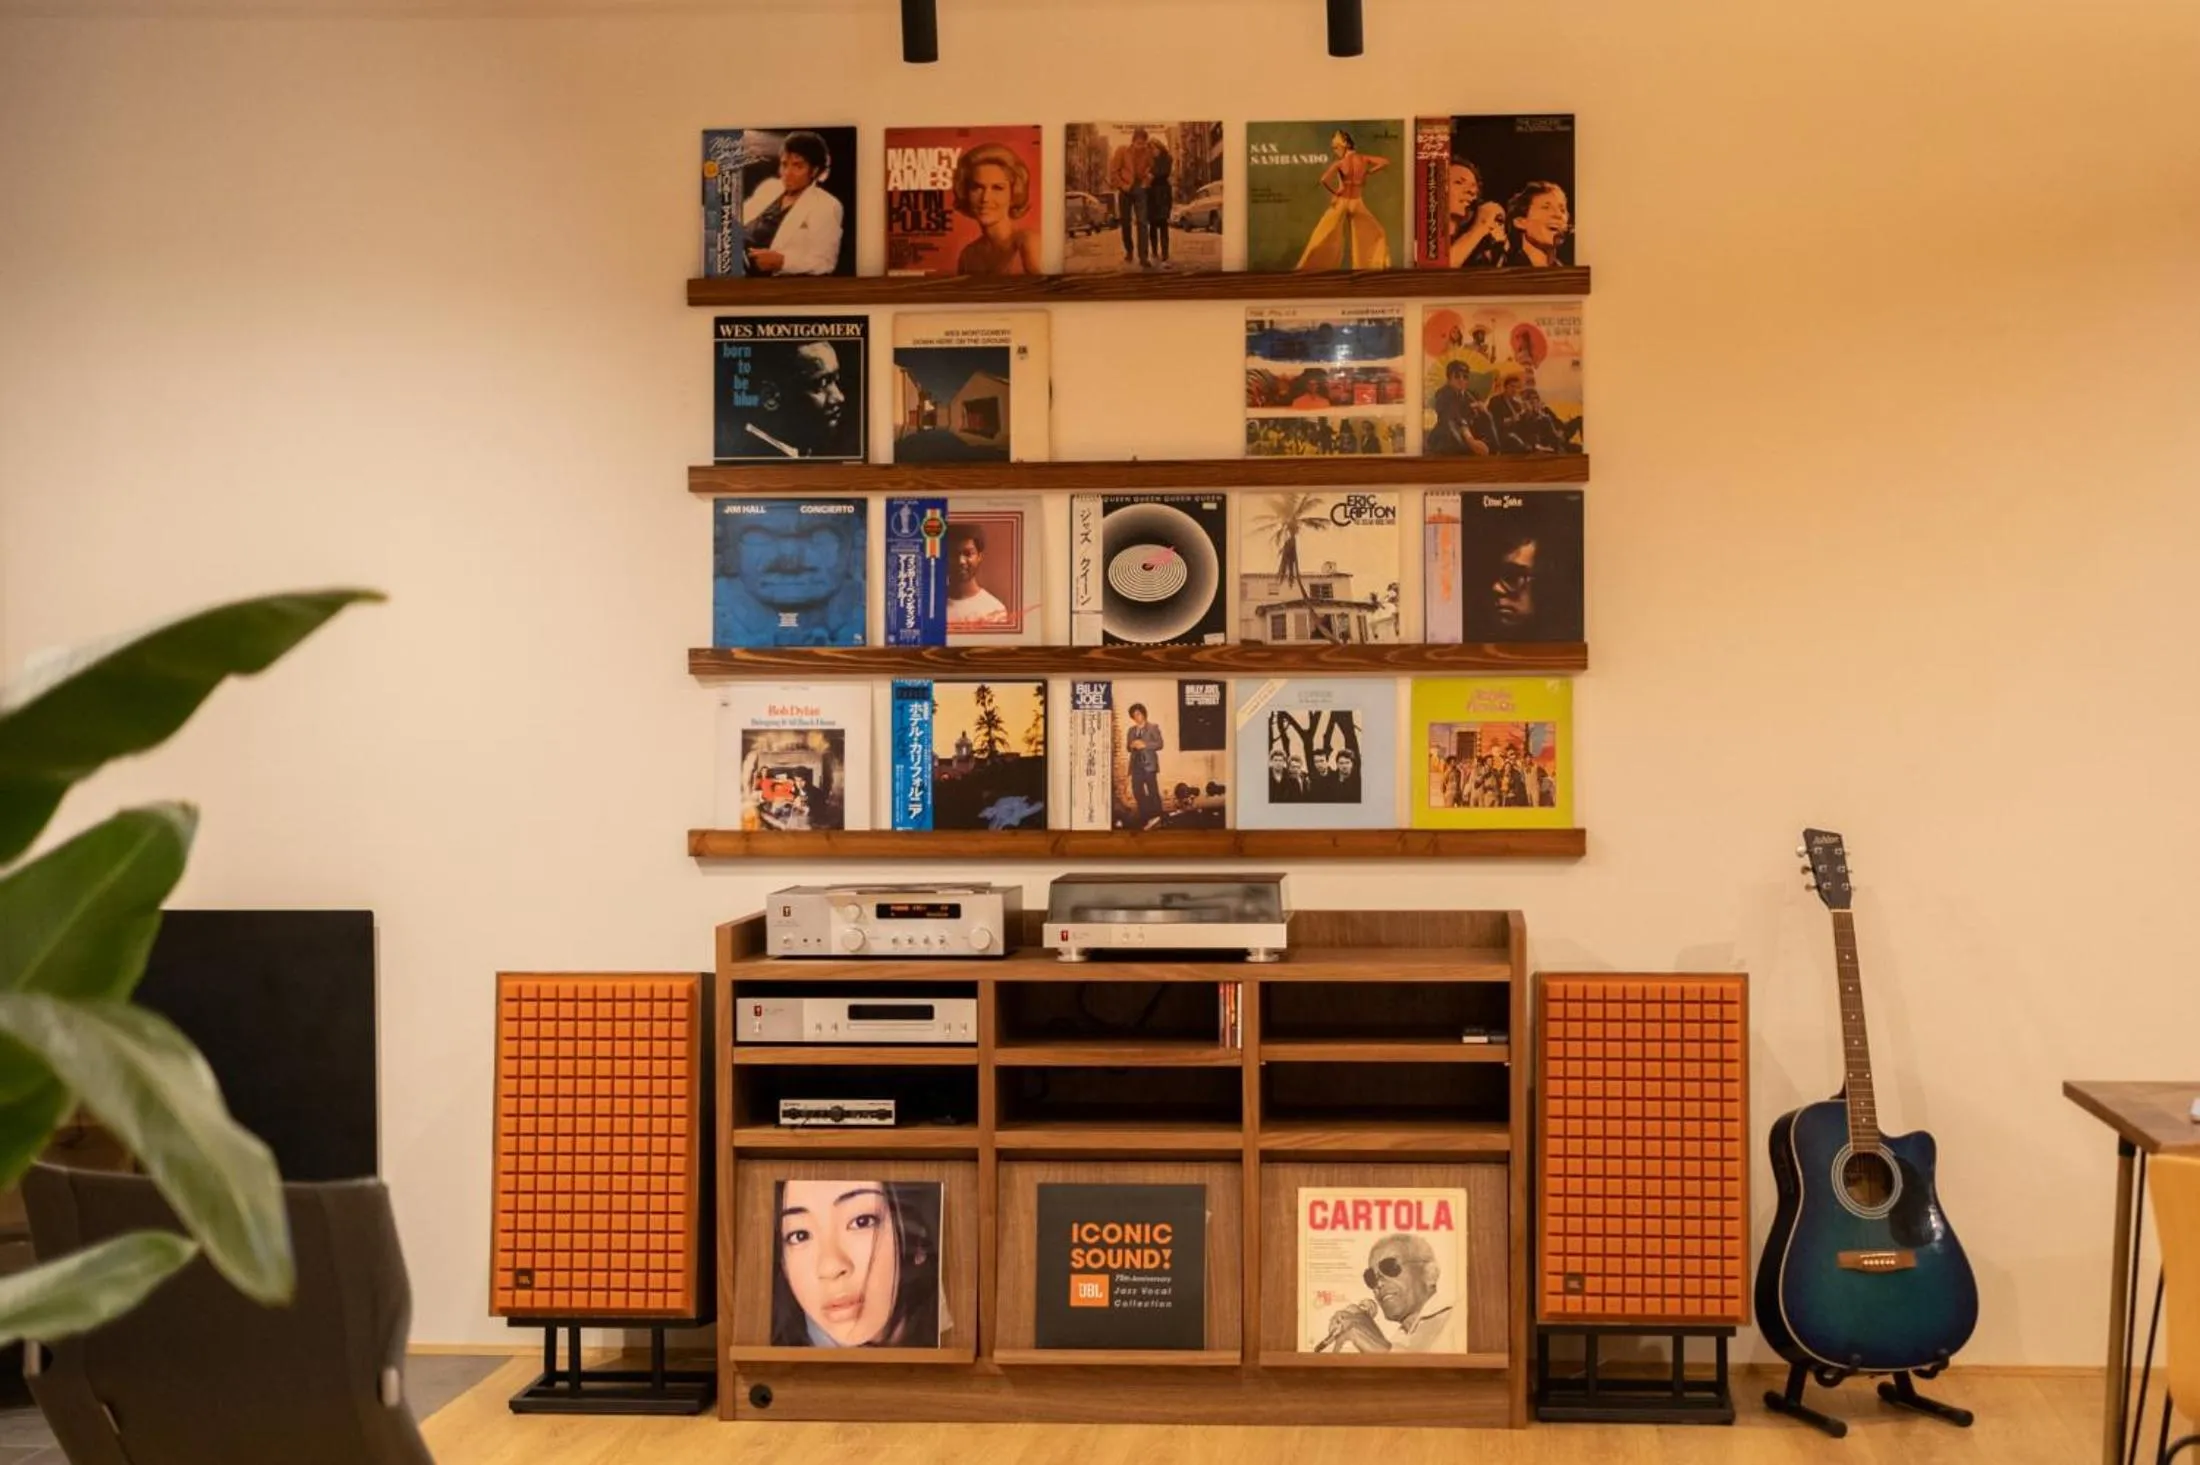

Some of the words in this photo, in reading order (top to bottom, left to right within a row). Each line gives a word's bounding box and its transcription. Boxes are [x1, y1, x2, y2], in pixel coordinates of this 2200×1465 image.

[1250, 143, 1278, 154] SAX
[888, 148, 961, 170] NANCY
[1250, 154, 1328, 165] SAMBANDO
[888, 169, 953, 191] AMES
[888, 190, 944, 211] LATIN
[888, 210, 953, 232] PULSE
[719, 324, 752, 336] WES
[756, 323, 862, 336] MONTGOMERY
[723, 342, 752, 358] born
[738, 360, 751, 373] to
[734, 375, 749, 389] be
[1347, 494, 1376, 507] ERIC
[724, 505, 741, 513] JIM
[742, 505, 766, 513] HALL
[800, 505, 855, 513] CONCIERTO
[1330, 503, 1396, 526] CLAPTON
[1080, 508, 1092, 544] ジャズ
[1080, 557, 1092, 606] クイーン
[1076, 683, 1107, 694] BILLY
[1076, 694, 1107, 704] JOEL
[768, 704, 789, 716] Bob
[790, 705, 820, 717] Dylan
[1309, 1199, 1455, 1231] CARTOLA
[1072, 1222, 1172, 1244] ICONIC
[1071, 1248, 1172, 1269] SOUND!
[1079, 1283, 1102, 1298] JBL
[1141, 1287, 1172, 1295] Vocal
[1114, 1300, 1172, 1308] Collection
